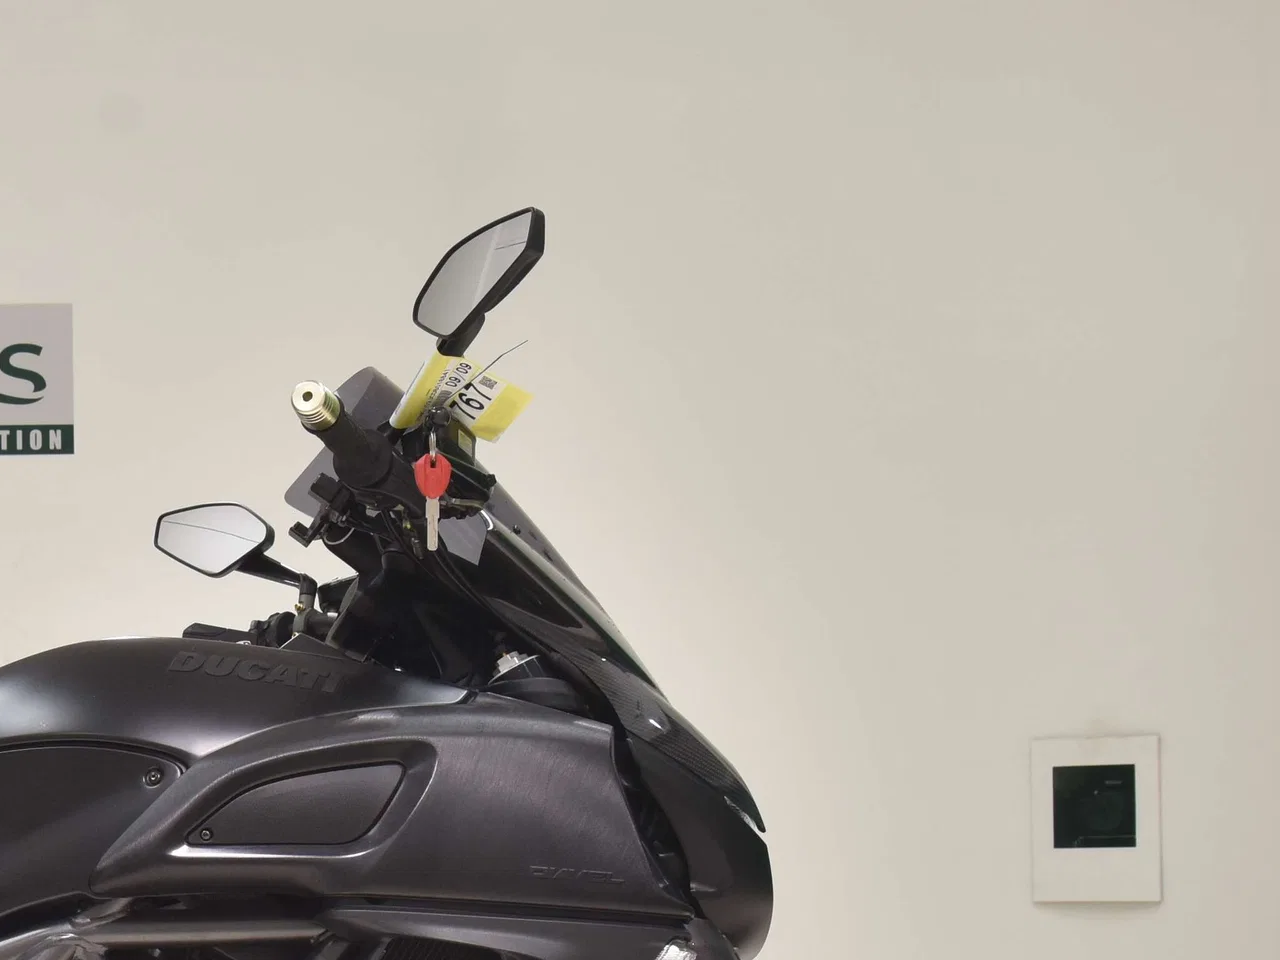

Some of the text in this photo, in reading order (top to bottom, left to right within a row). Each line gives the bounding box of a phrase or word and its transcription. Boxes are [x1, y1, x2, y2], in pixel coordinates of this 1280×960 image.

[445, 362, 472, 388] 09/09
[449, 381, 492, 420] 767
[167, 650, 351, 693] DUCATI
